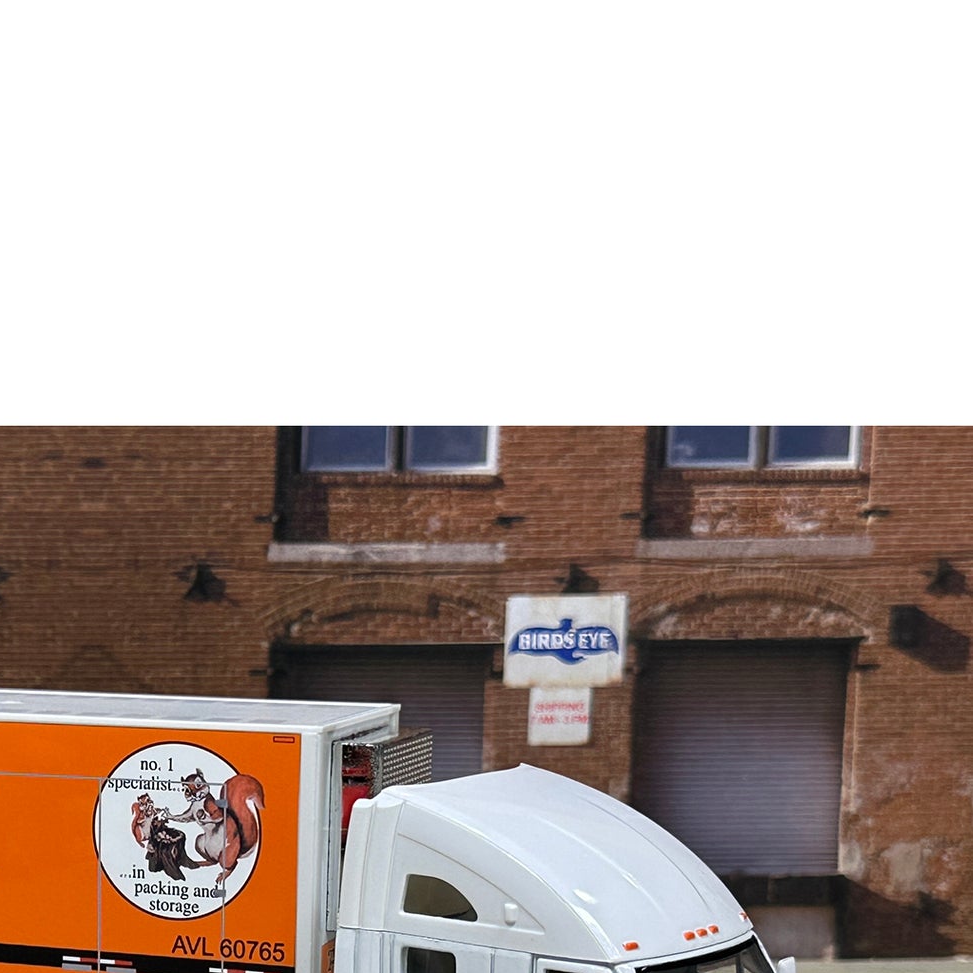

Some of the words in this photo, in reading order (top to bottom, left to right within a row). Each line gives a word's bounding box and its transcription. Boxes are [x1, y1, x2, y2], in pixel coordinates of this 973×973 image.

[518, 633, 575, 650] BIRDS
[579, 632, 611, 650] EYE
[140, 759, 162, 771] no.
[167, 758, 173, 771] 1
[134, 883, 188, 899] packing
[193, 885, 220, 898] and
[149, 899, 199, 916] storage
[172, 935, 214, 957] AVL
[220, 938, 285, 962] 60765
